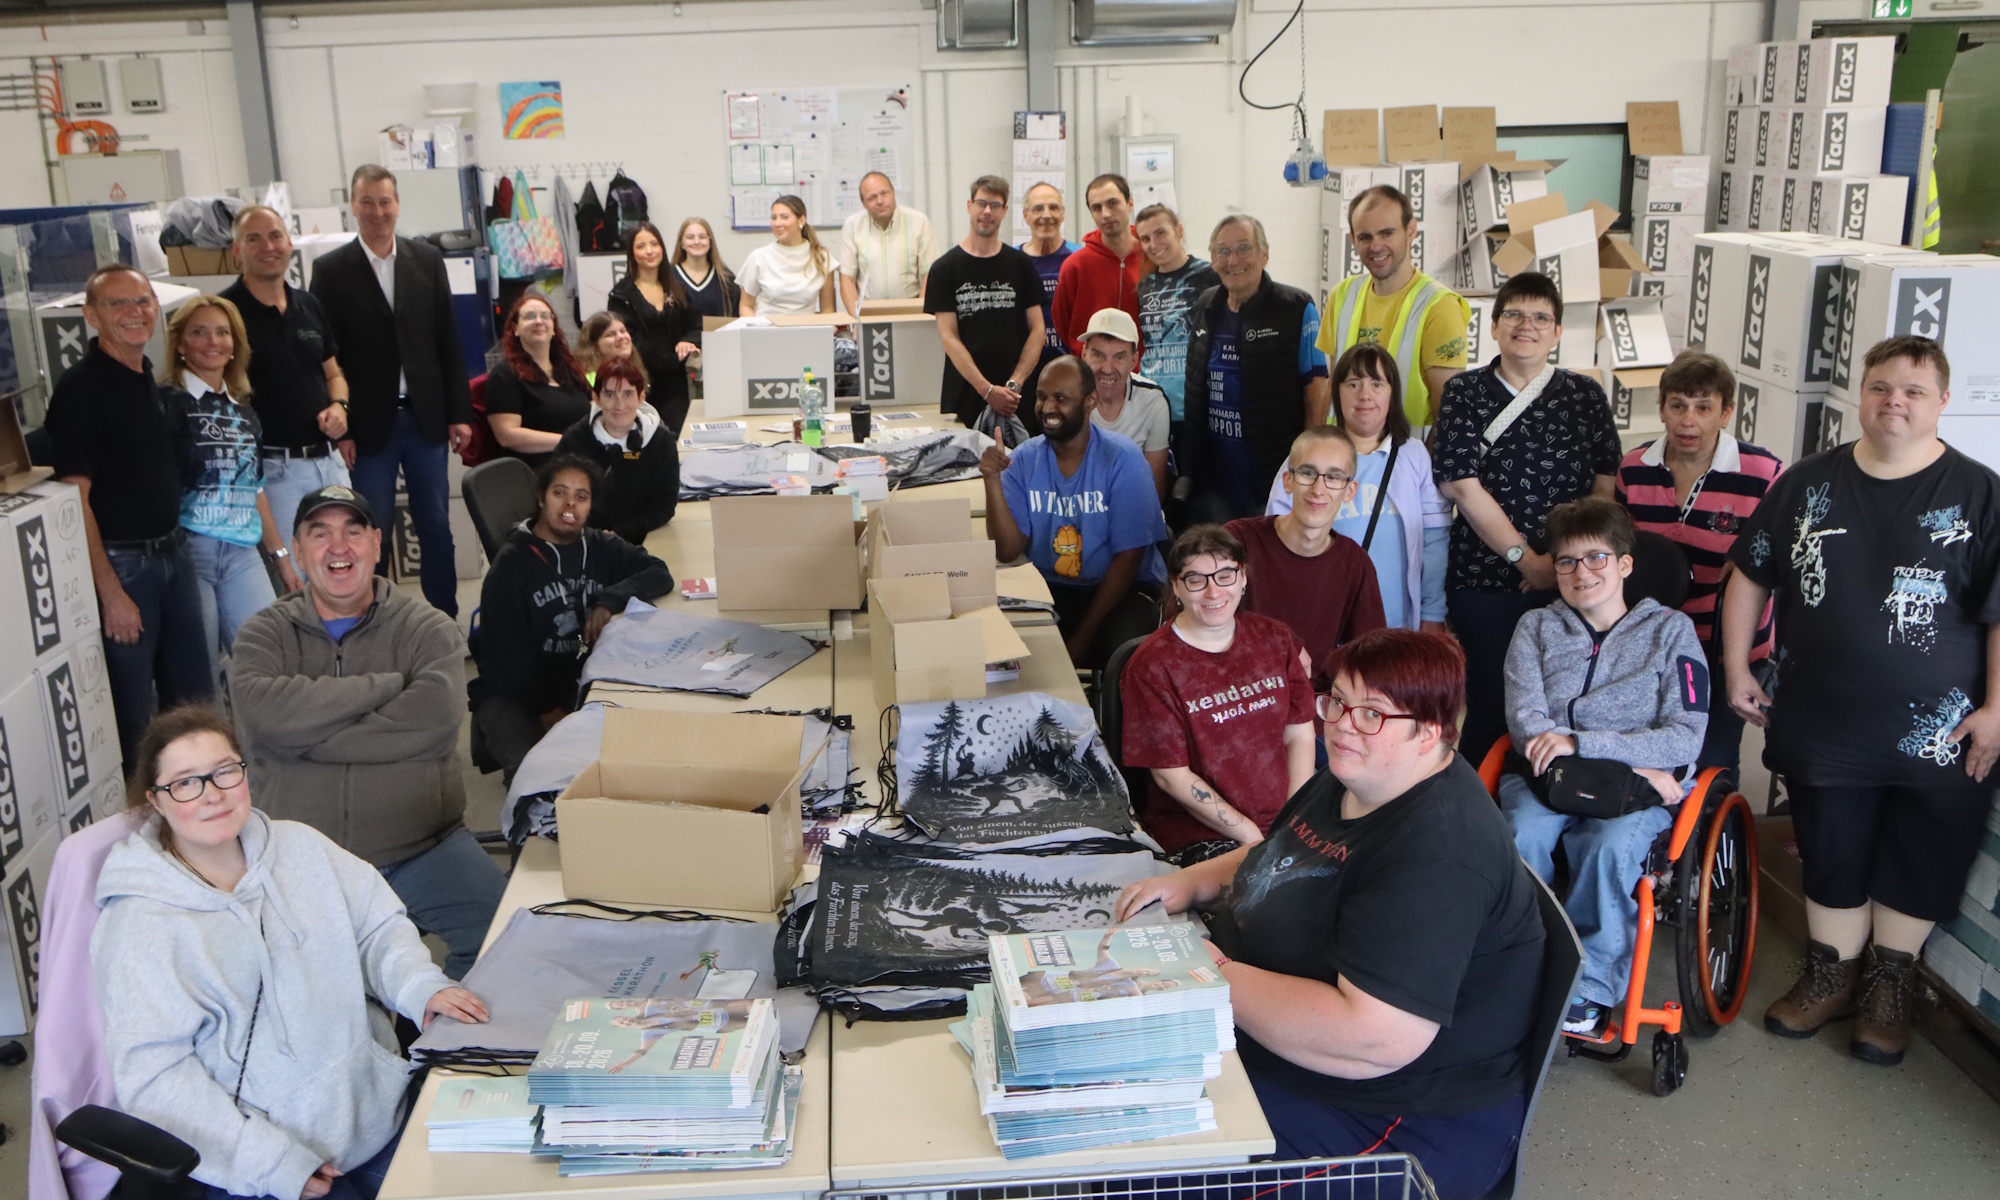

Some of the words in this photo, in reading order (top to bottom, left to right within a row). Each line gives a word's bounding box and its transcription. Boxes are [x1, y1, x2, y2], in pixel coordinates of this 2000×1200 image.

[1764, 50, 1777, 100] Tacx
[1796, 49, 1809, 101] Tacx
[1834, 46, 1855, 100] Tacx
[1016, 112, 1025, 138] 2026
[1757, 115, 1769, 164] Tacx
[1789, 117, 1802, 168] Tacx
[1825, 116, 1845, 169] Tacx
[1411, 172, 1423, 218] Tacx
[1464, 183, 1477, 233] Tacx
[1749, 179, 1762, 228] Tacx
[1782, 182, 1795, 231] Tacx
[1808, 185, 1822, 234] Tacx
[1845, 187, 1866, 239] Tacx
[1649, 222, 1667, 269] Tacx
[1690, 252, 1711, 344] Tacx
[1743, 262, 1768, 361] Tacx
[1614, 312, 1635, 359] Tacx
[1812, 272, 1841, 376] Tacx
[1836, 273, 1857, 380] Tacx
[869, 328, 890, 396] Tacx
[1209, 408, 1241, 419] AMMARA
[25, 526, 57, 646] Tacx
[55, 672, 85, 789] Tacx
[977, 821, 1017, 829] einem,
[978, 829, 1031, 838] Fürchten
[827, 894, 845, 927] Fürchten
[831, 882, 845, 896] das
[852, 884, 869, 899] Von
[16, 881, 39, 1003] Tacx
[850, 921, 864, 931] der
[1048, 935, 1071, 965] MARATHON
[1125, 928, 1149, 948] 2026
[1031, 938, 1050, 965] MAGAZIN
[607, 968, 634, 994] KASSEL
[622, 956, 656, 996] MARATHON
[587, 1049, 612, 1069] 2026
[674, 1037, 701, 1070] MARATHON
[694, 1039, 719, 1068] MAGAZIN
